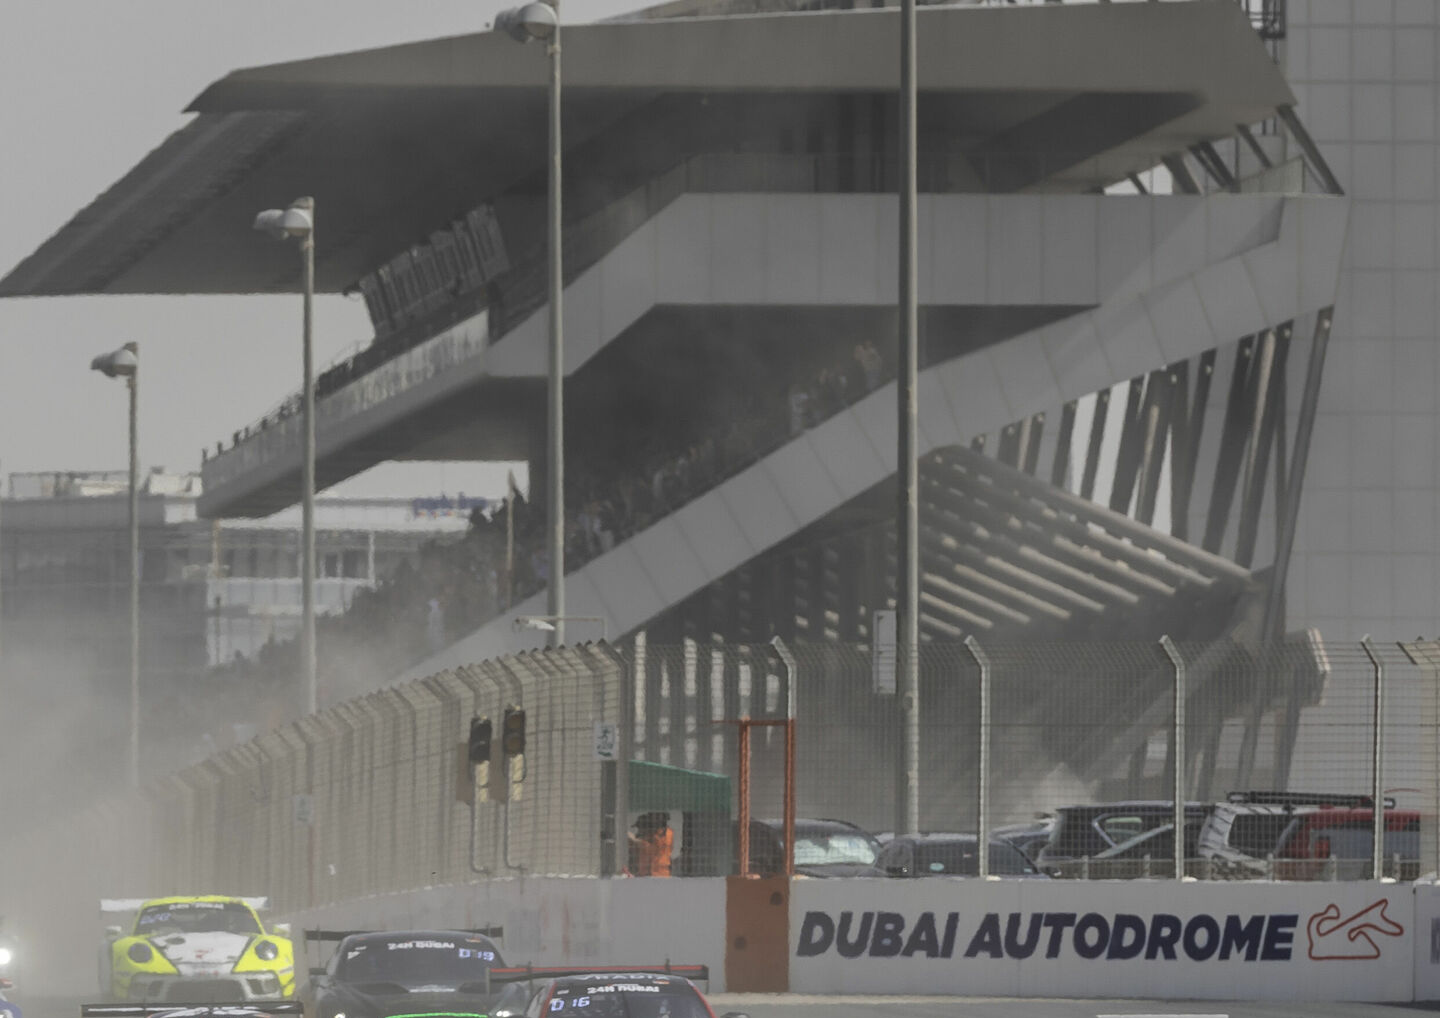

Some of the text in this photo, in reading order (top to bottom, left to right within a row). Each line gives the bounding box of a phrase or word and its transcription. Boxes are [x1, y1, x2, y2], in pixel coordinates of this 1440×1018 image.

[797, 911, 1298, 962] DUBAI AUTODROME
[587, 984, 660, 993] 24H DUBAI
